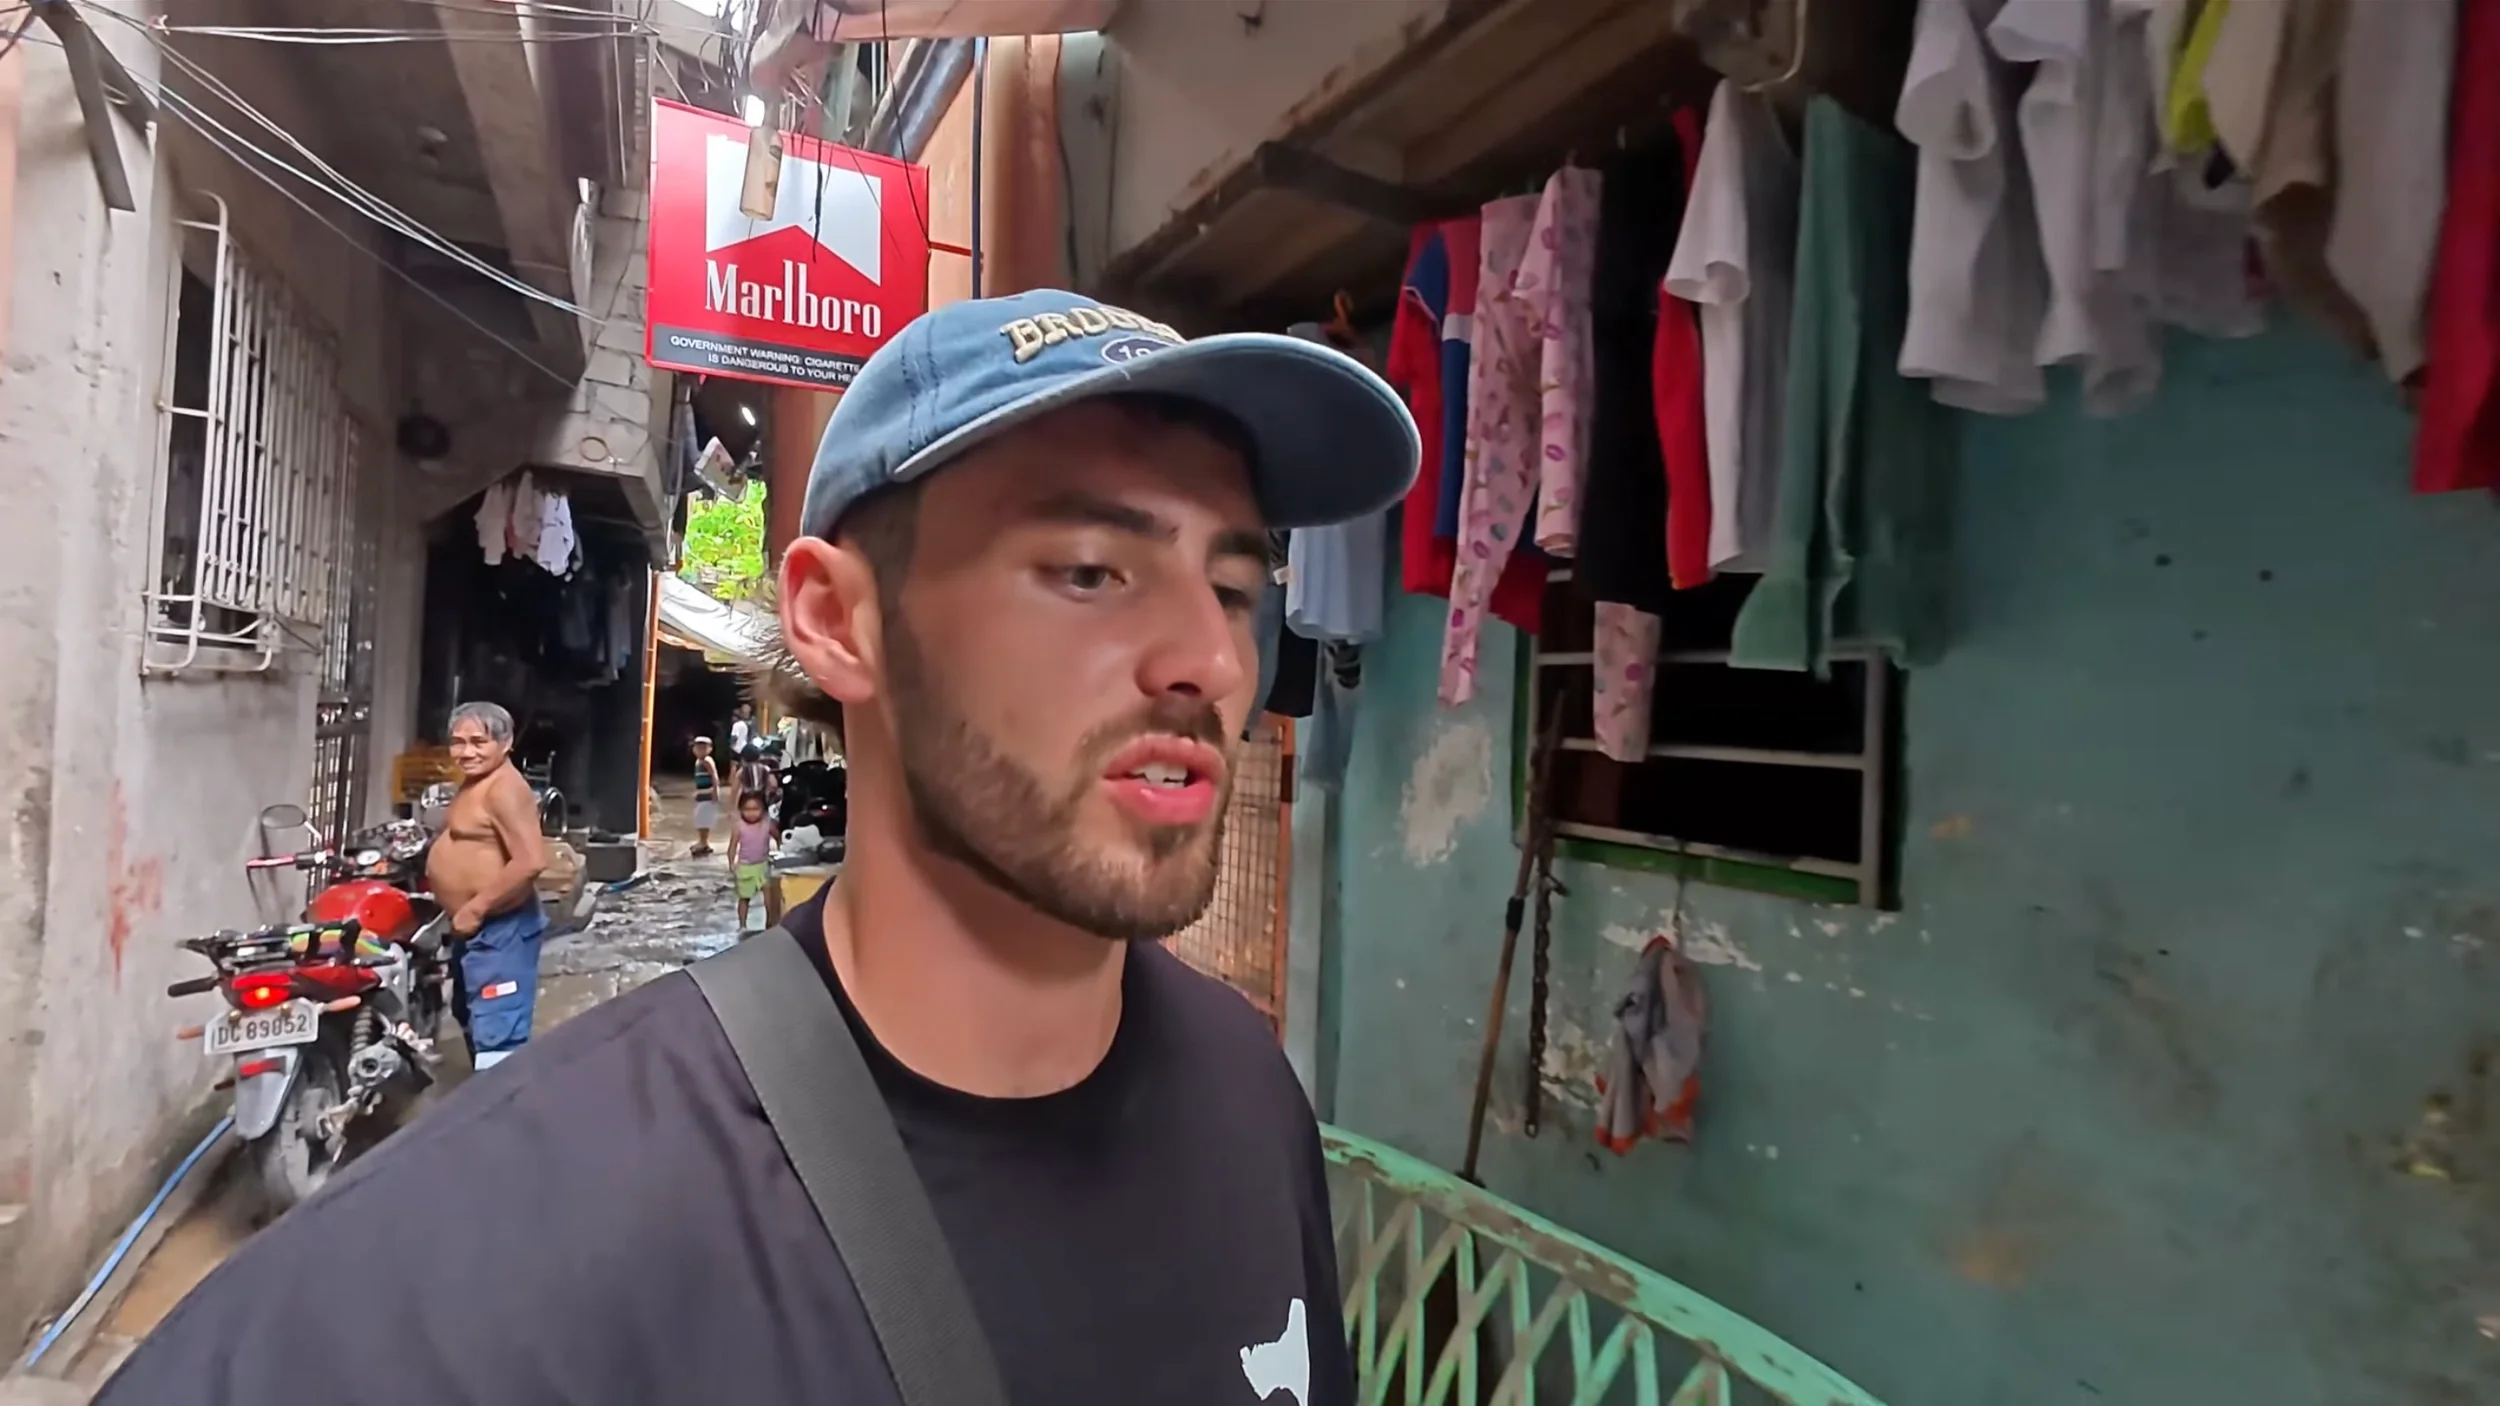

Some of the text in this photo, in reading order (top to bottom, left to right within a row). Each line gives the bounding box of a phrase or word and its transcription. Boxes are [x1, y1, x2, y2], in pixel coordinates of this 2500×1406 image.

[705, 258, 881, 338] Marlboro
[670, 335, 748, 357] GOVERNMENT
[708, 354, 856, 384] IS DANGEROUS TO YOUR HE
[218, 1025, 241, 1045] DC
